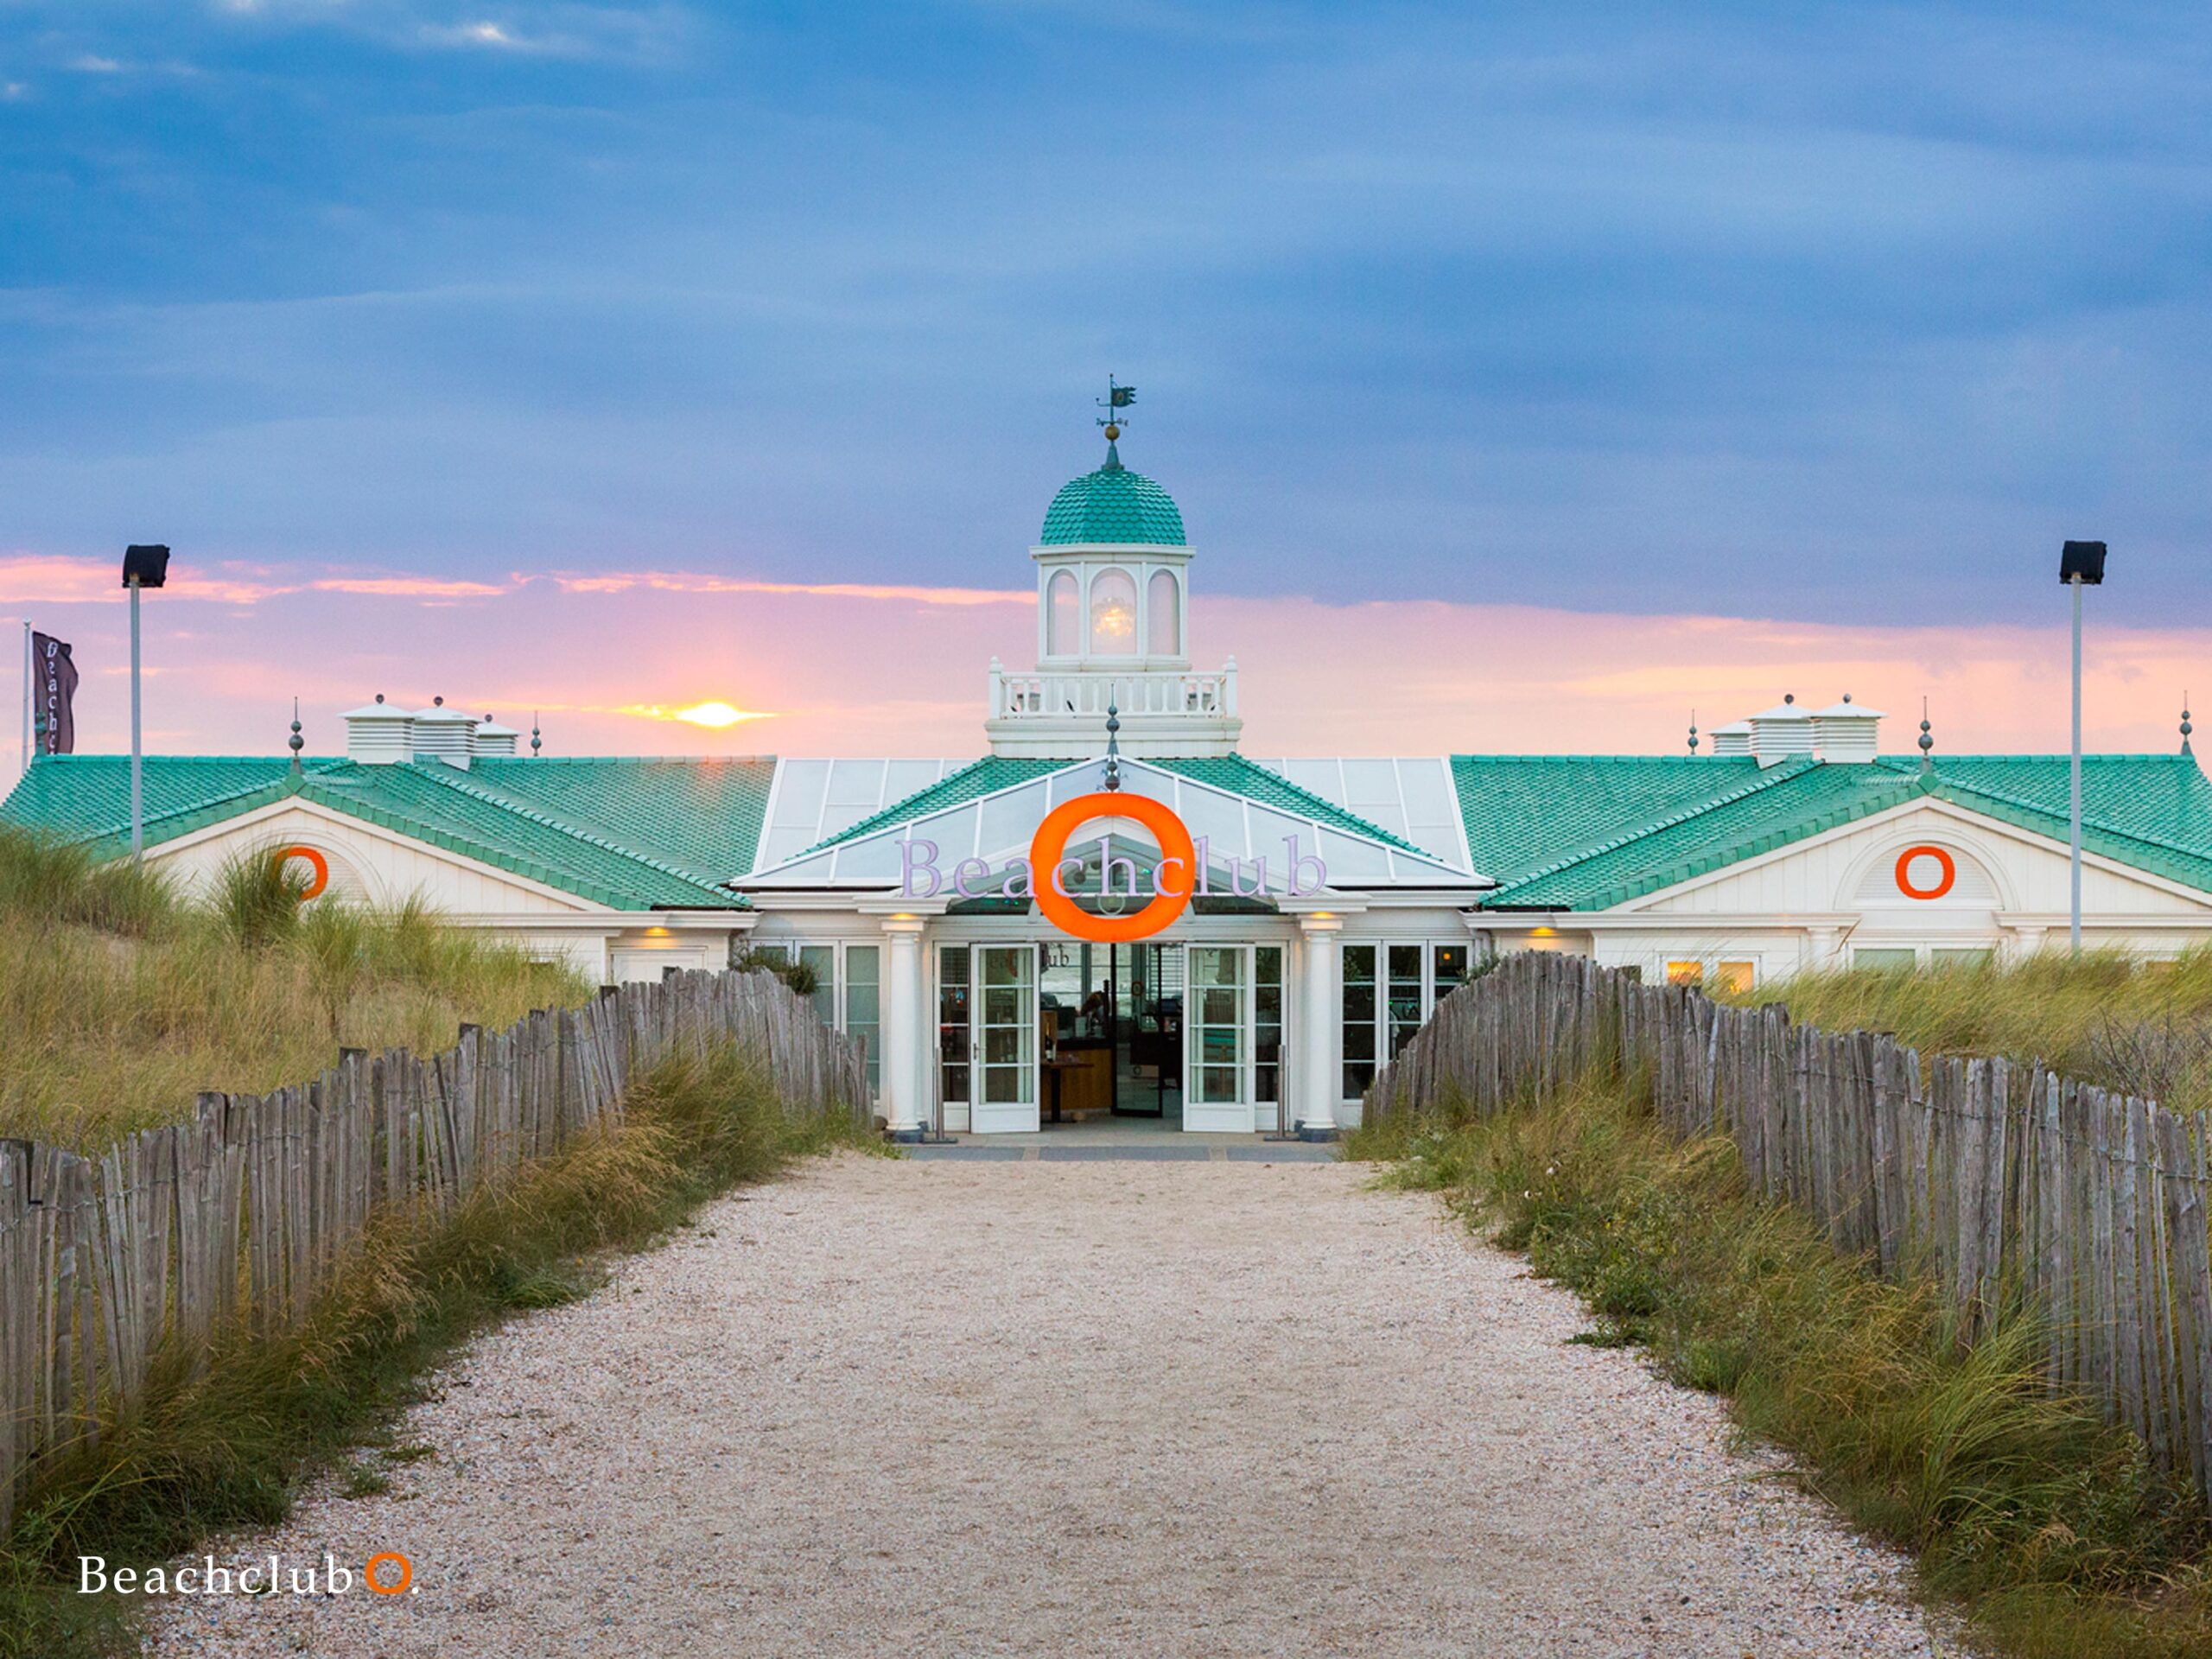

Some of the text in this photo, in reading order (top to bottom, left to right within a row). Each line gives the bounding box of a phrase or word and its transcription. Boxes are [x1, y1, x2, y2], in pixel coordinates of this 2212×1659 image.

[894, 834, 1327, 899] Beachclub
[1030, 791, 1196, 943] O
[1895, 846, 1955, 900] O
